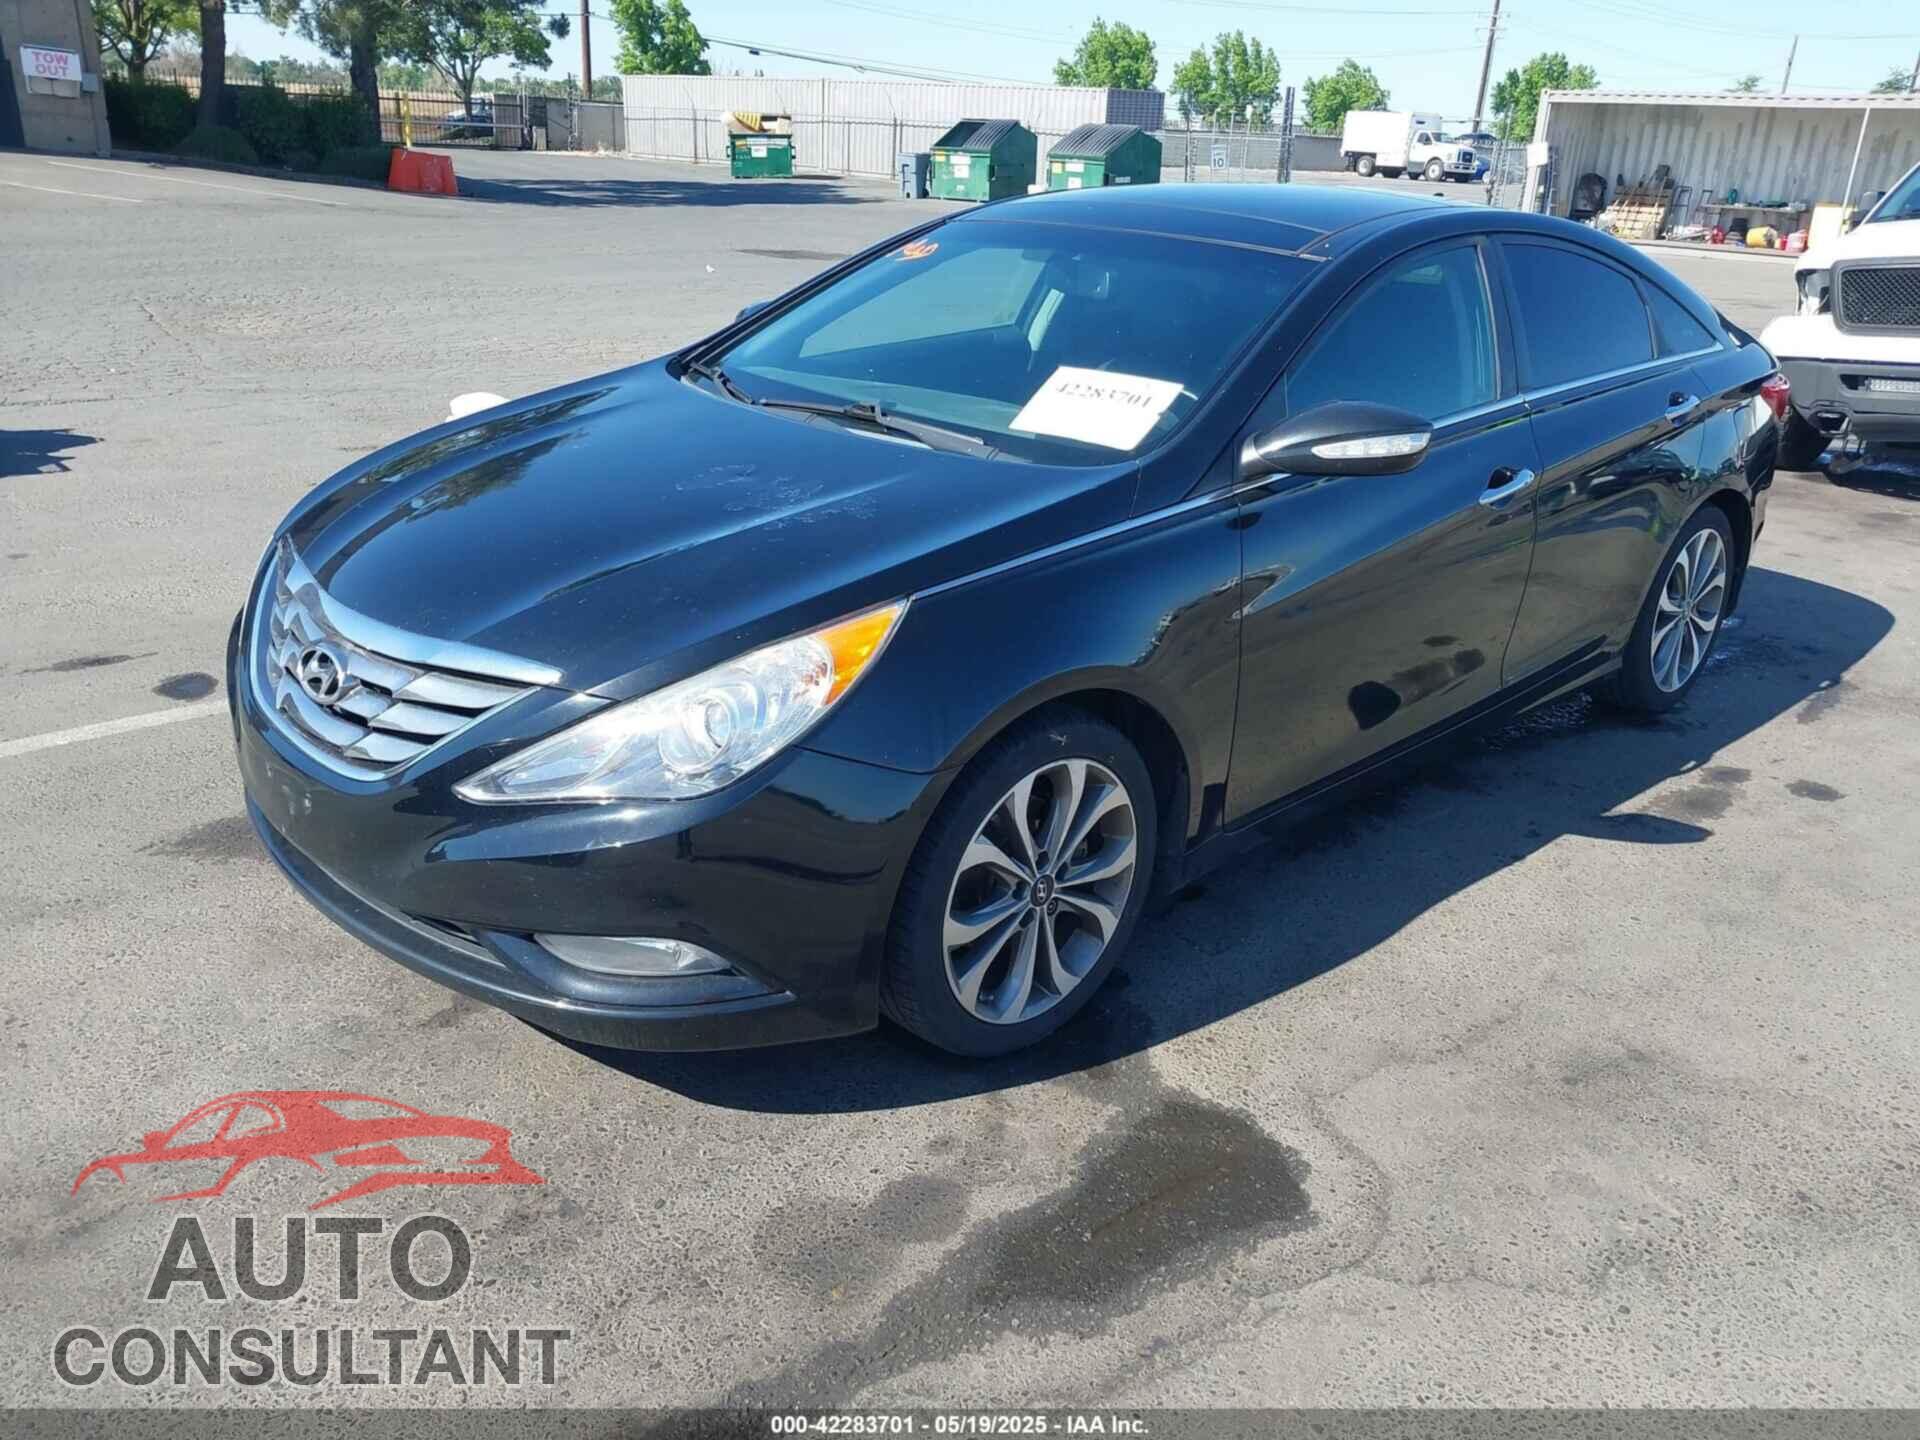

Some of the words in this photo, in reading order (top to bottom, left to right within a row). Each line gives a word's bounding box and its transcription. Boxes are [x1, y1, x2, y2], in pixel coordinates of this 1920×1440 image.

[31, 51, 69, 66] TOW
[35, 63, 69, 77] OUT
[1213, 157, 1225, 169] 10
